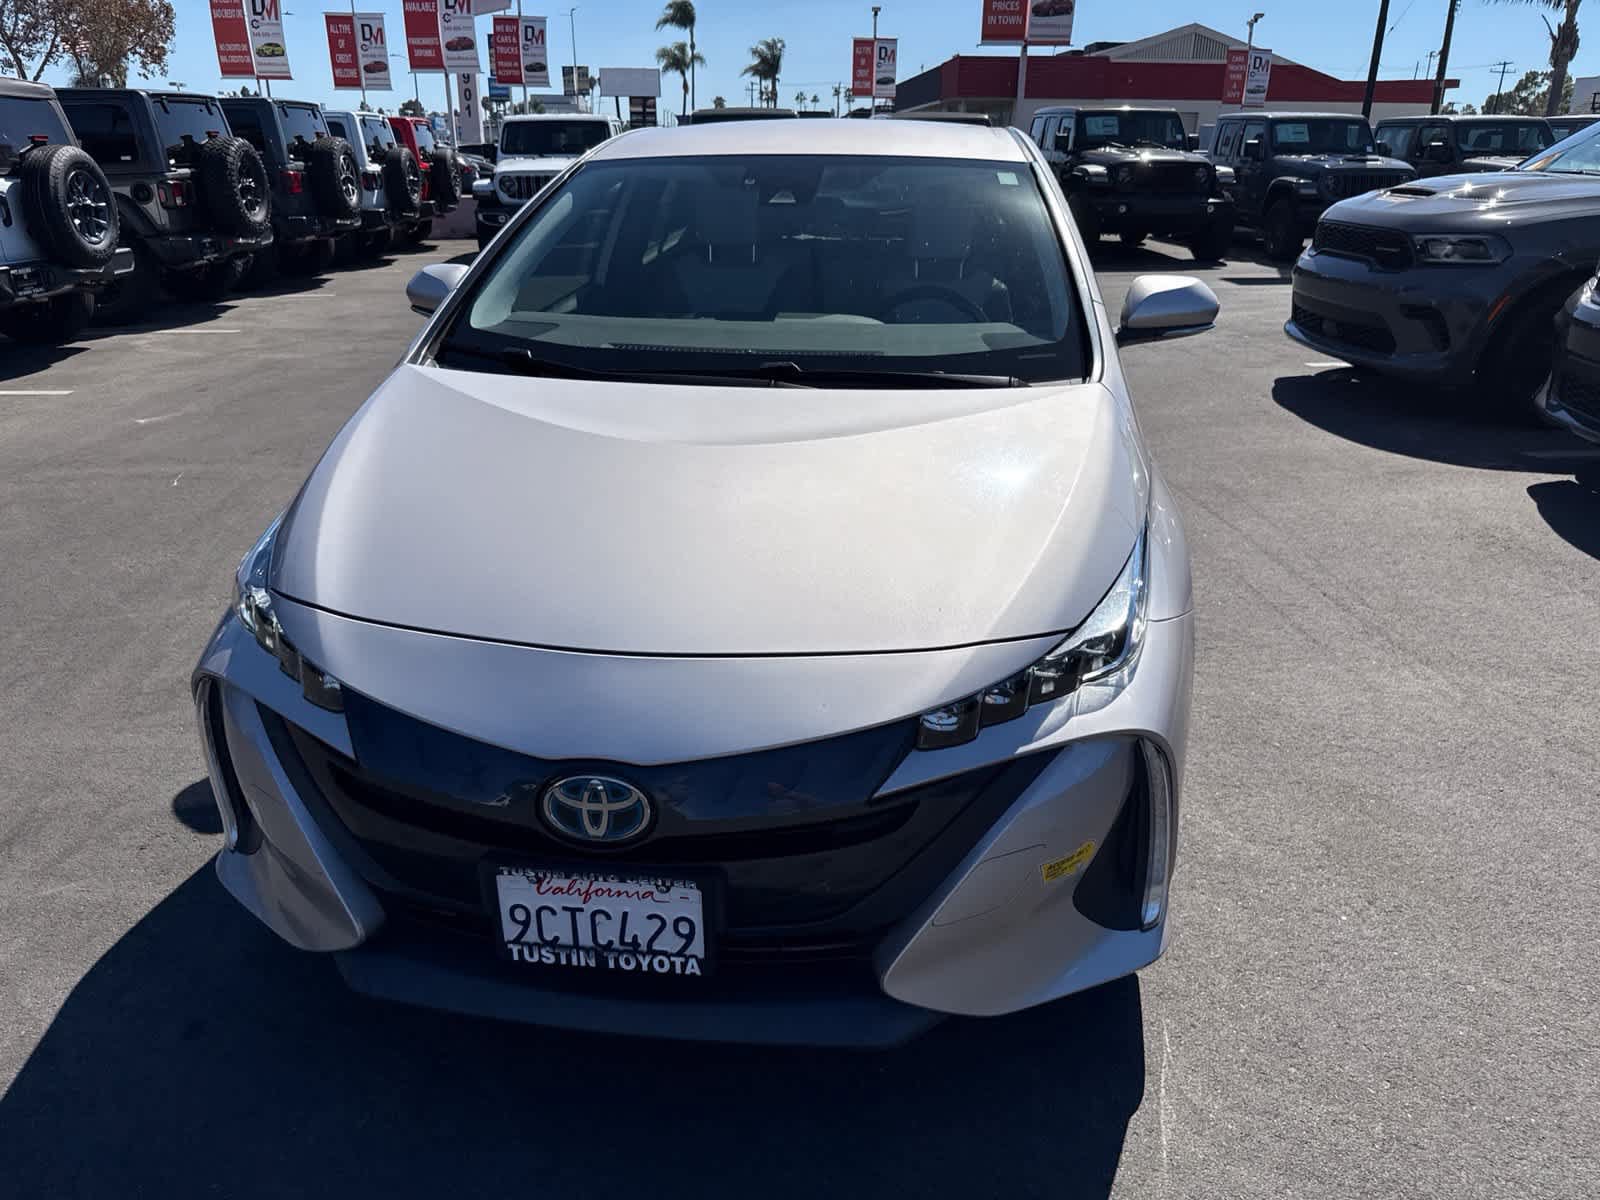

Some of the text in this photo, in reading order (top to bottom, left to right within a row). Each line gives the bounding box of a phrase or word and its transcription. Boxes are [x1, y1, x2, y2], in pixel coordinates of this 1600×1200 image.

[404, 1, 436, 12] AVAILABLE
[992, 1, 1020, 11] PRICES
[987, 15, 1023, 25] IN TOWN
[496, 46, 518, 55] TRUCKS
[536, 877, 669, 905] California
[508, 903, 697, 955] 9CTC429
[507, 943, 702, 976] TUSTIN TOYOTA
